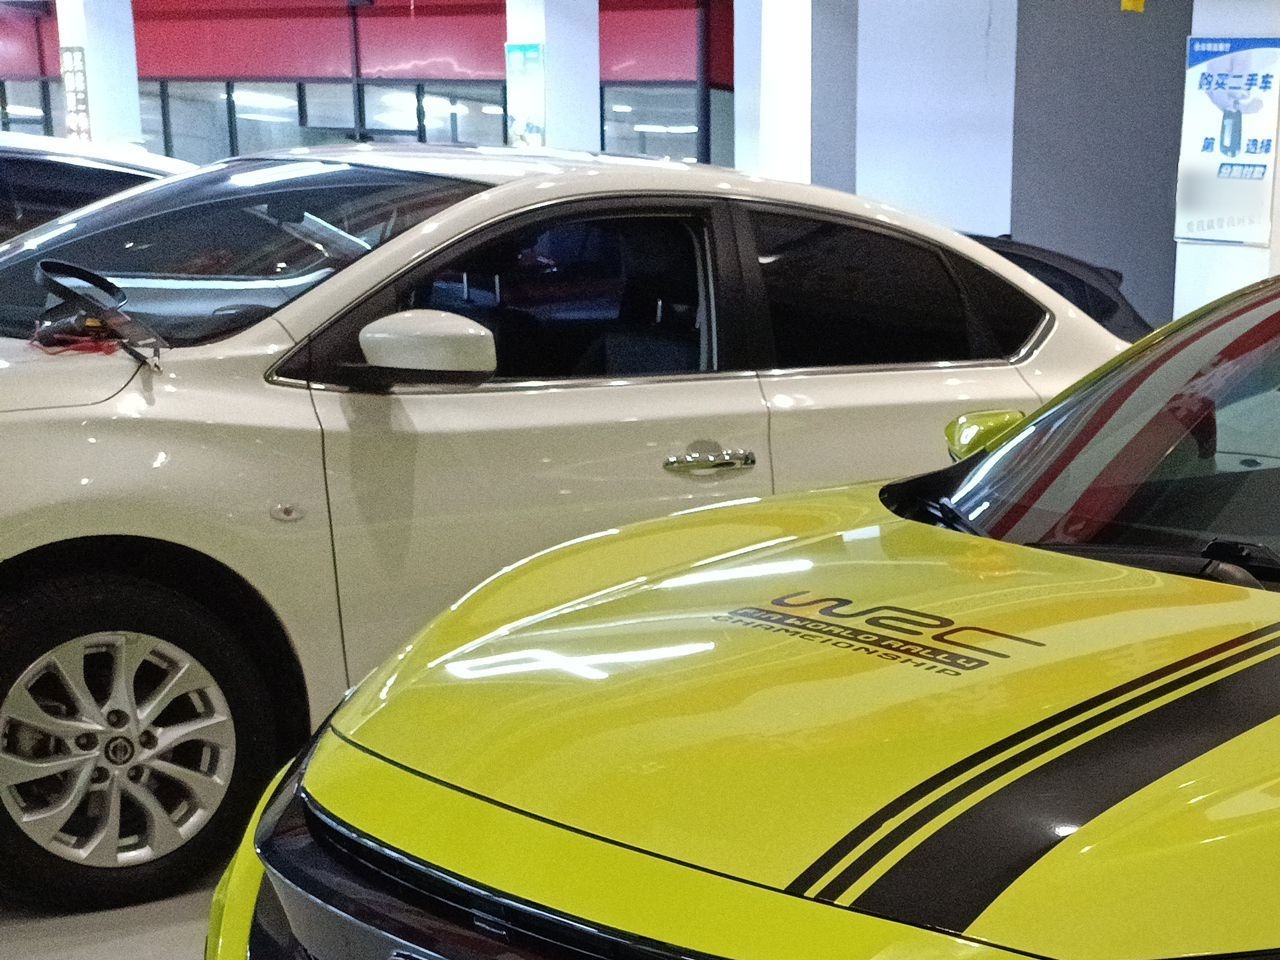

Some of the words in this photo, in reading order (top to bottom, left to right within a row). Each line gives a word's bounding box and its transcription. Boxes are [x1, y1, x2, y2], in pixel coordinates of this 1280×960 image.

[771, 590, 1046, 659] WRC
[784, 617, 879, 641] WORLD
[880, 639, 979, 668] RALLY
